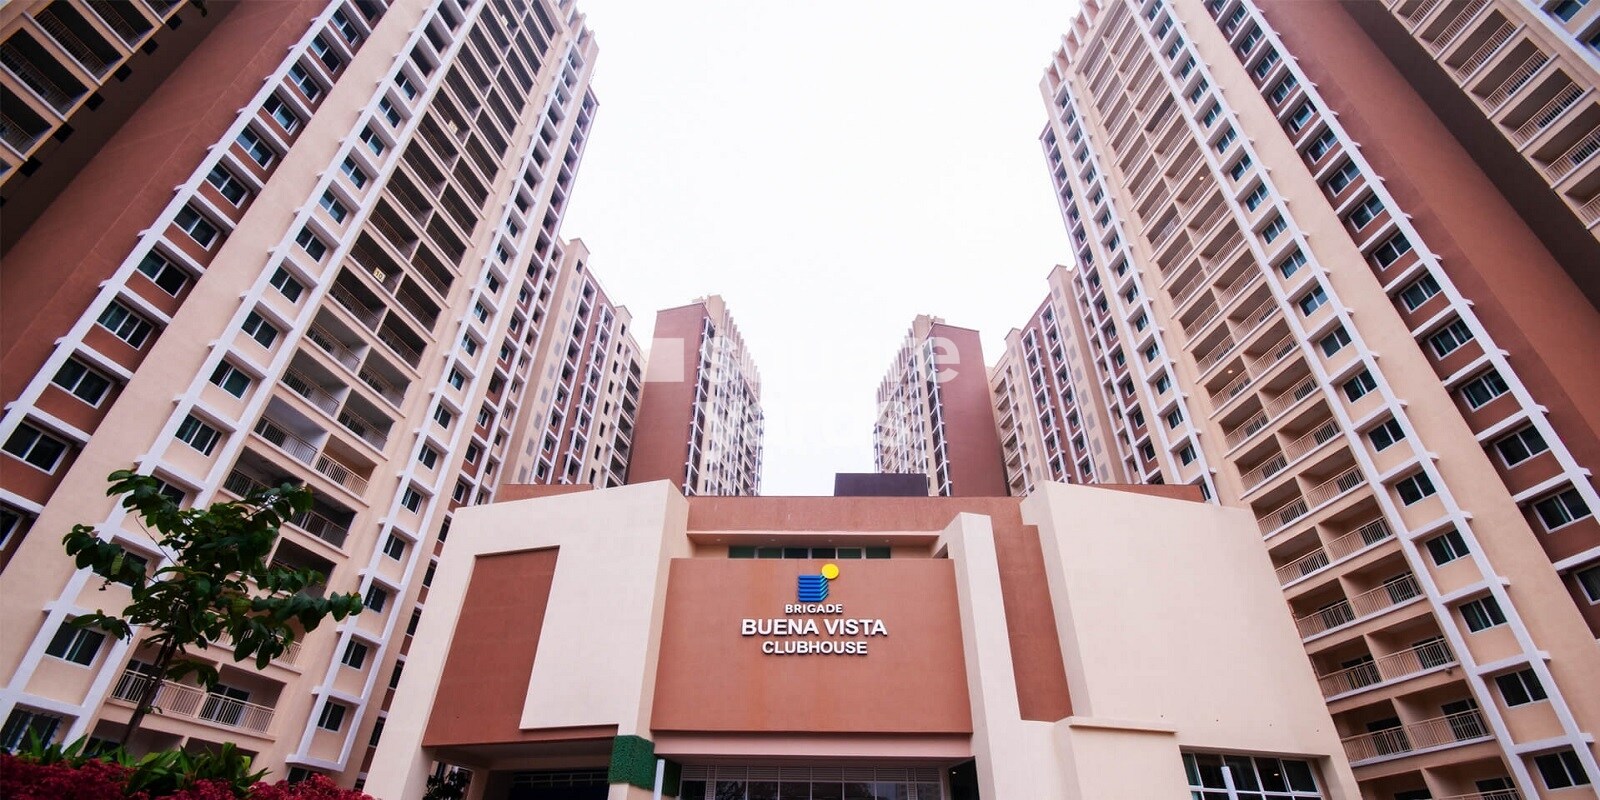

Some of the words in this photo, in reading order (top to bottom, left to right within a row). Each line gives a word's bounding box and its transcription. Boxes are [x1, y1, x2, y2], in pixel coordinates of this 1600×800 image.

[785, 603, 844, 614] BRIGADE
[741, 618, 820, 636] BUENA
[823, 618, 888, 636] VISTA
[762, 640, 868, 655] CLUBHOUSE
